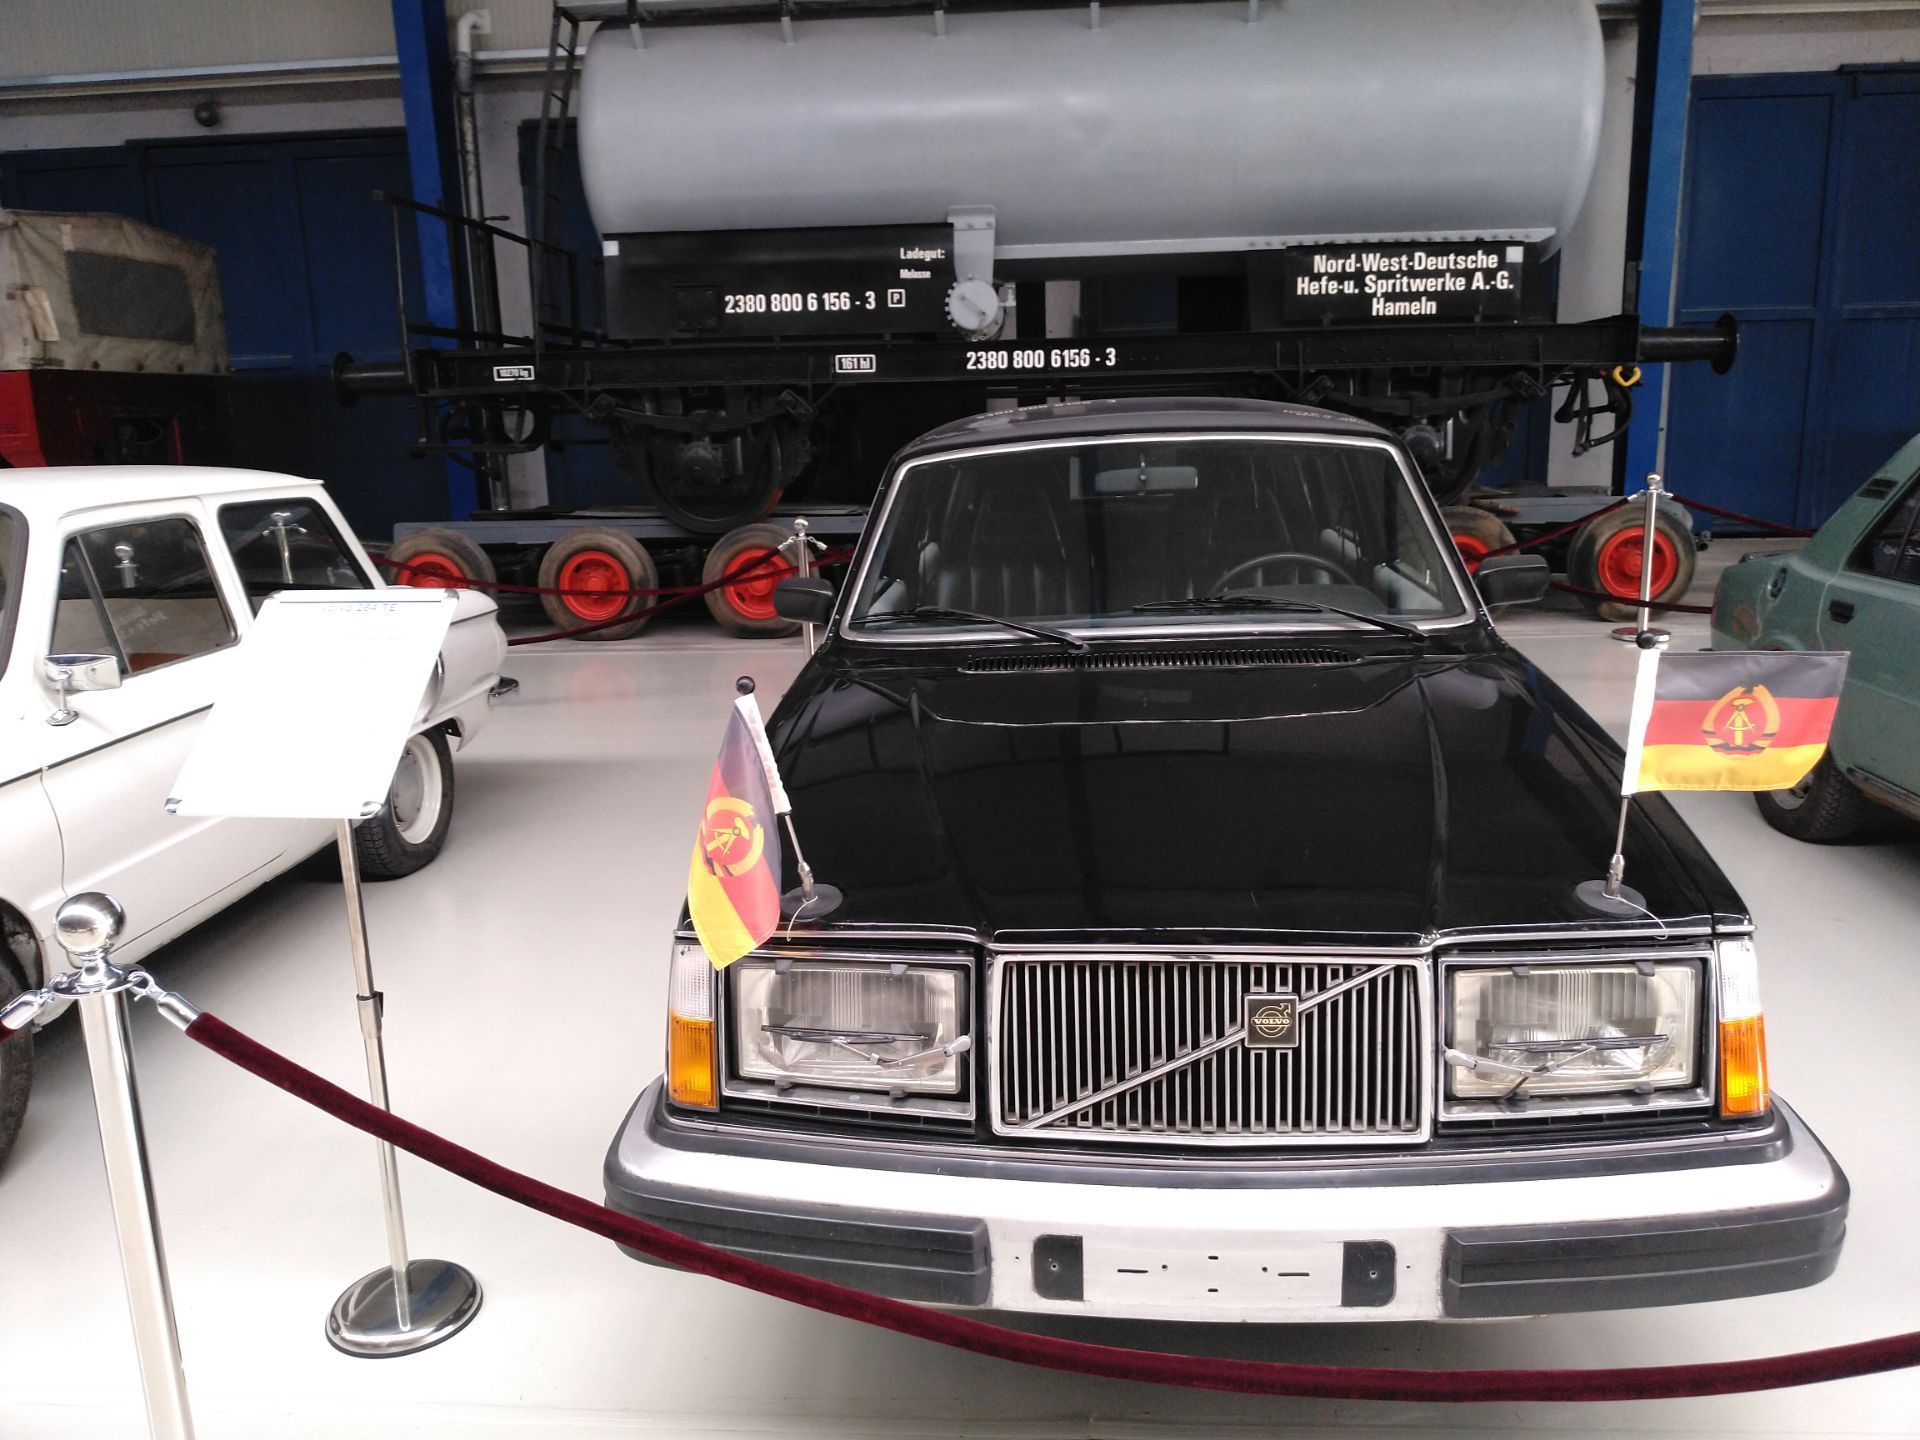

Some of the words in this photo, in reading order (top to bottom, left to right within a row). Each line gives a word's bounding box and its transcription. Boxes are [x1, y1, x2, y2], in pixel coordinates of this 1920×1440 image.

[900, 247, 945, 261] Ladegut:
[1313, 250, 1498, 273] Nord-West-Deutsche
[1296, 275, 1359, 295] Hefe-u.
[1364, 272, 1466, 297] Spritwerke
[724, 295, 766, 313] 2380
[770, 293, 803, 312] 800
[865, 291, 876, 310] 3
[892, 293, 900, 303] P
[1372, 296, 1437, 316] Hameln
[841, 357, 858, 369] 161
[966, 351, 1008, 370] 2380
[1012, 350, 1045, 369] 800
[1050, 349, 1091, 368] 6156
[1105, 347, 1116, 367] 3
